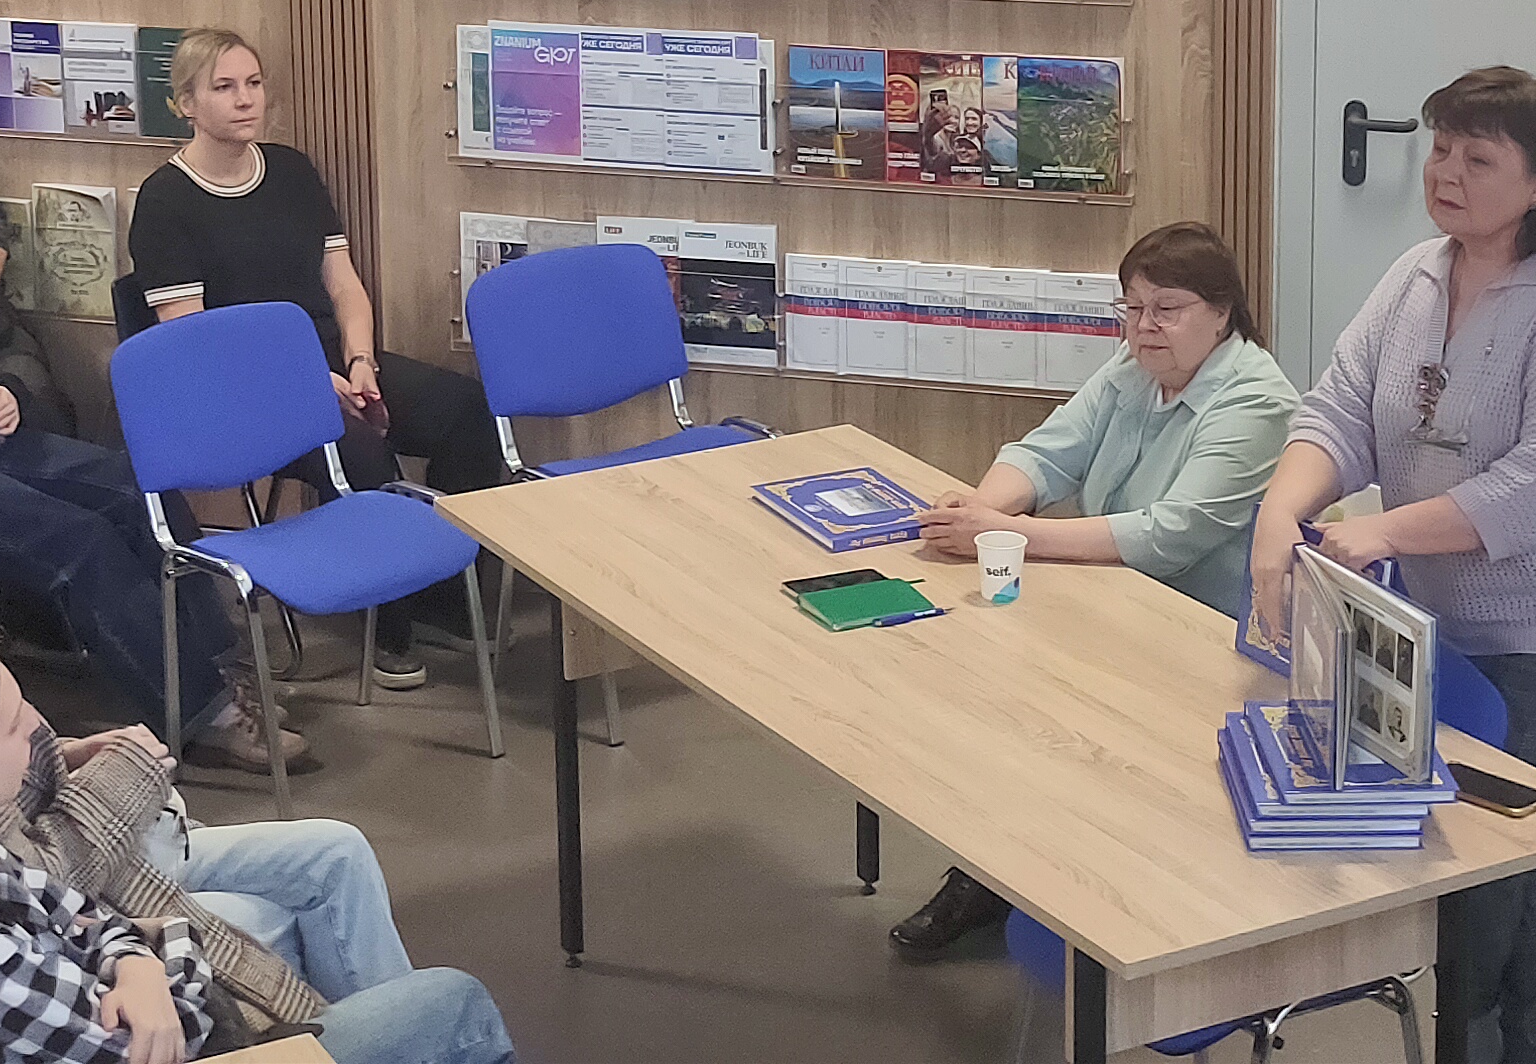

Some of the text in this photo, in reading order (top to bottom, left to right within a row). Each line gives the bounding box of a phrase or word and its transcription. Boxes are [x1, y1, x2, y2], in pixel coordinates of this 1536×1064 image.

[494, 35, 541, 48] ZNANIUM
[665, 43, 731, 54] УЖЕ СЕГОДНЯ
